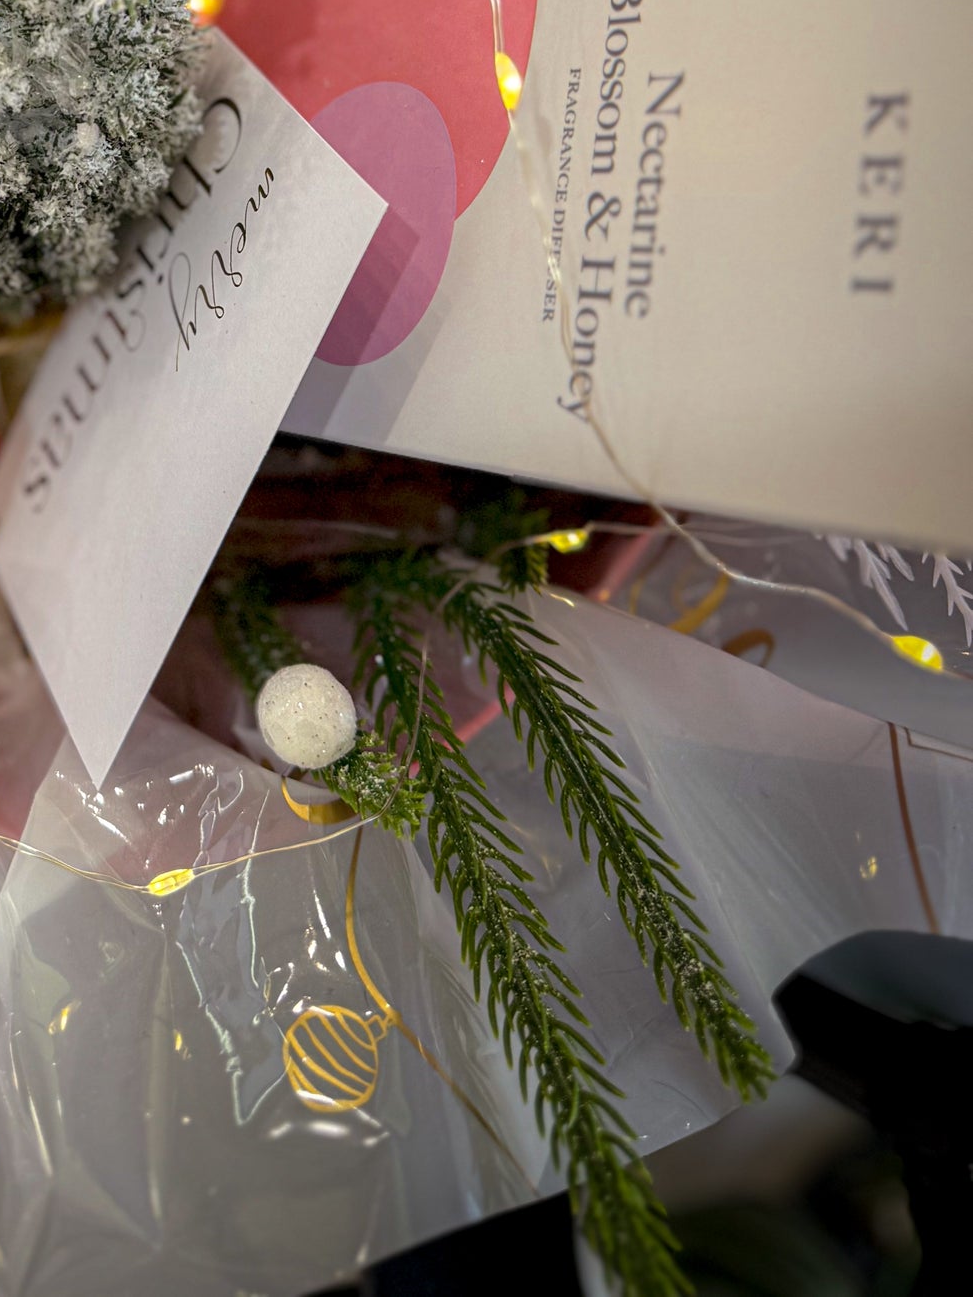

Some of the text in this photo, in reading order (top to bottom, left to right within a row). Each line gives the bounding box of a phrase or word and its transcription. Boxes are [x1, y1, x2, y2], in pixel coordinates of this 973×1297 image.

[553, 66, 583, 204] FRAGRANCE
[583, 188, 626, 242] &
[626, 70, 685, 320] Nectarine
[850, 89, 913, 300] KERI
[21, 95, 244, 514] Christmas
[165, 165, 276, 373] merry
[555, 252, 620, 425] Honey
